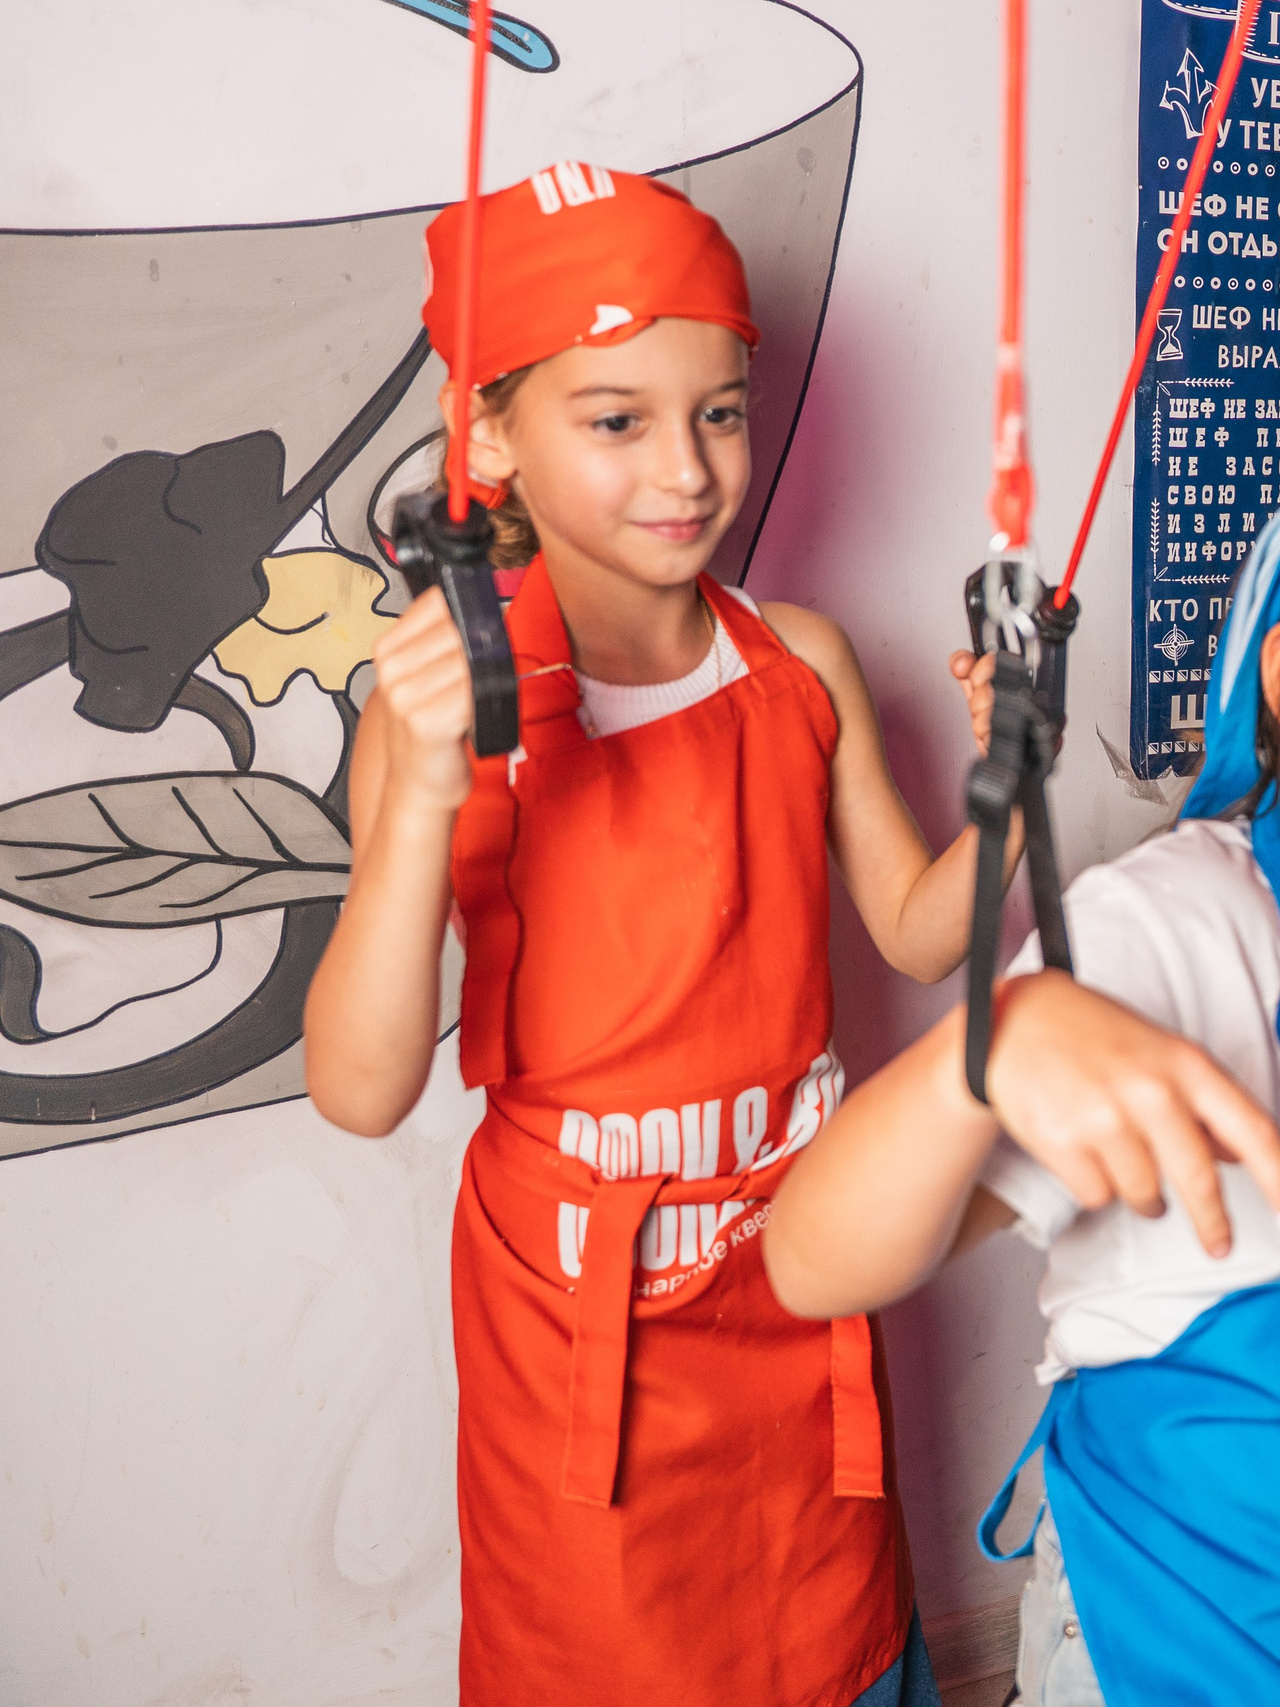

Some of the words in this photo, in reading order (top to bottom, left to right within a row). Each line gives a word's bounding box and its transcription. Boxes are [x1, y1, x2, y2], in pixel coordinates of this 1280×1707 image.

[1216, 118, 1230, 148] У
[1235, 195, 1270, 221] НЕ
[1156, 227, 1199, 254] ОН
[1192, 304, 1251, 330] ШЕФ
[1168, 397, 1216, 420] ШЕФ
[1223, 398, 1247, 420] НЕ
[1168, 426, 1230, 448] ШЕФ
[1167, 456, 1199, 477] НЕ
[1167, 484, 1236, 505] СВОЮ
[1149, 598, 1199, 622] КТО
